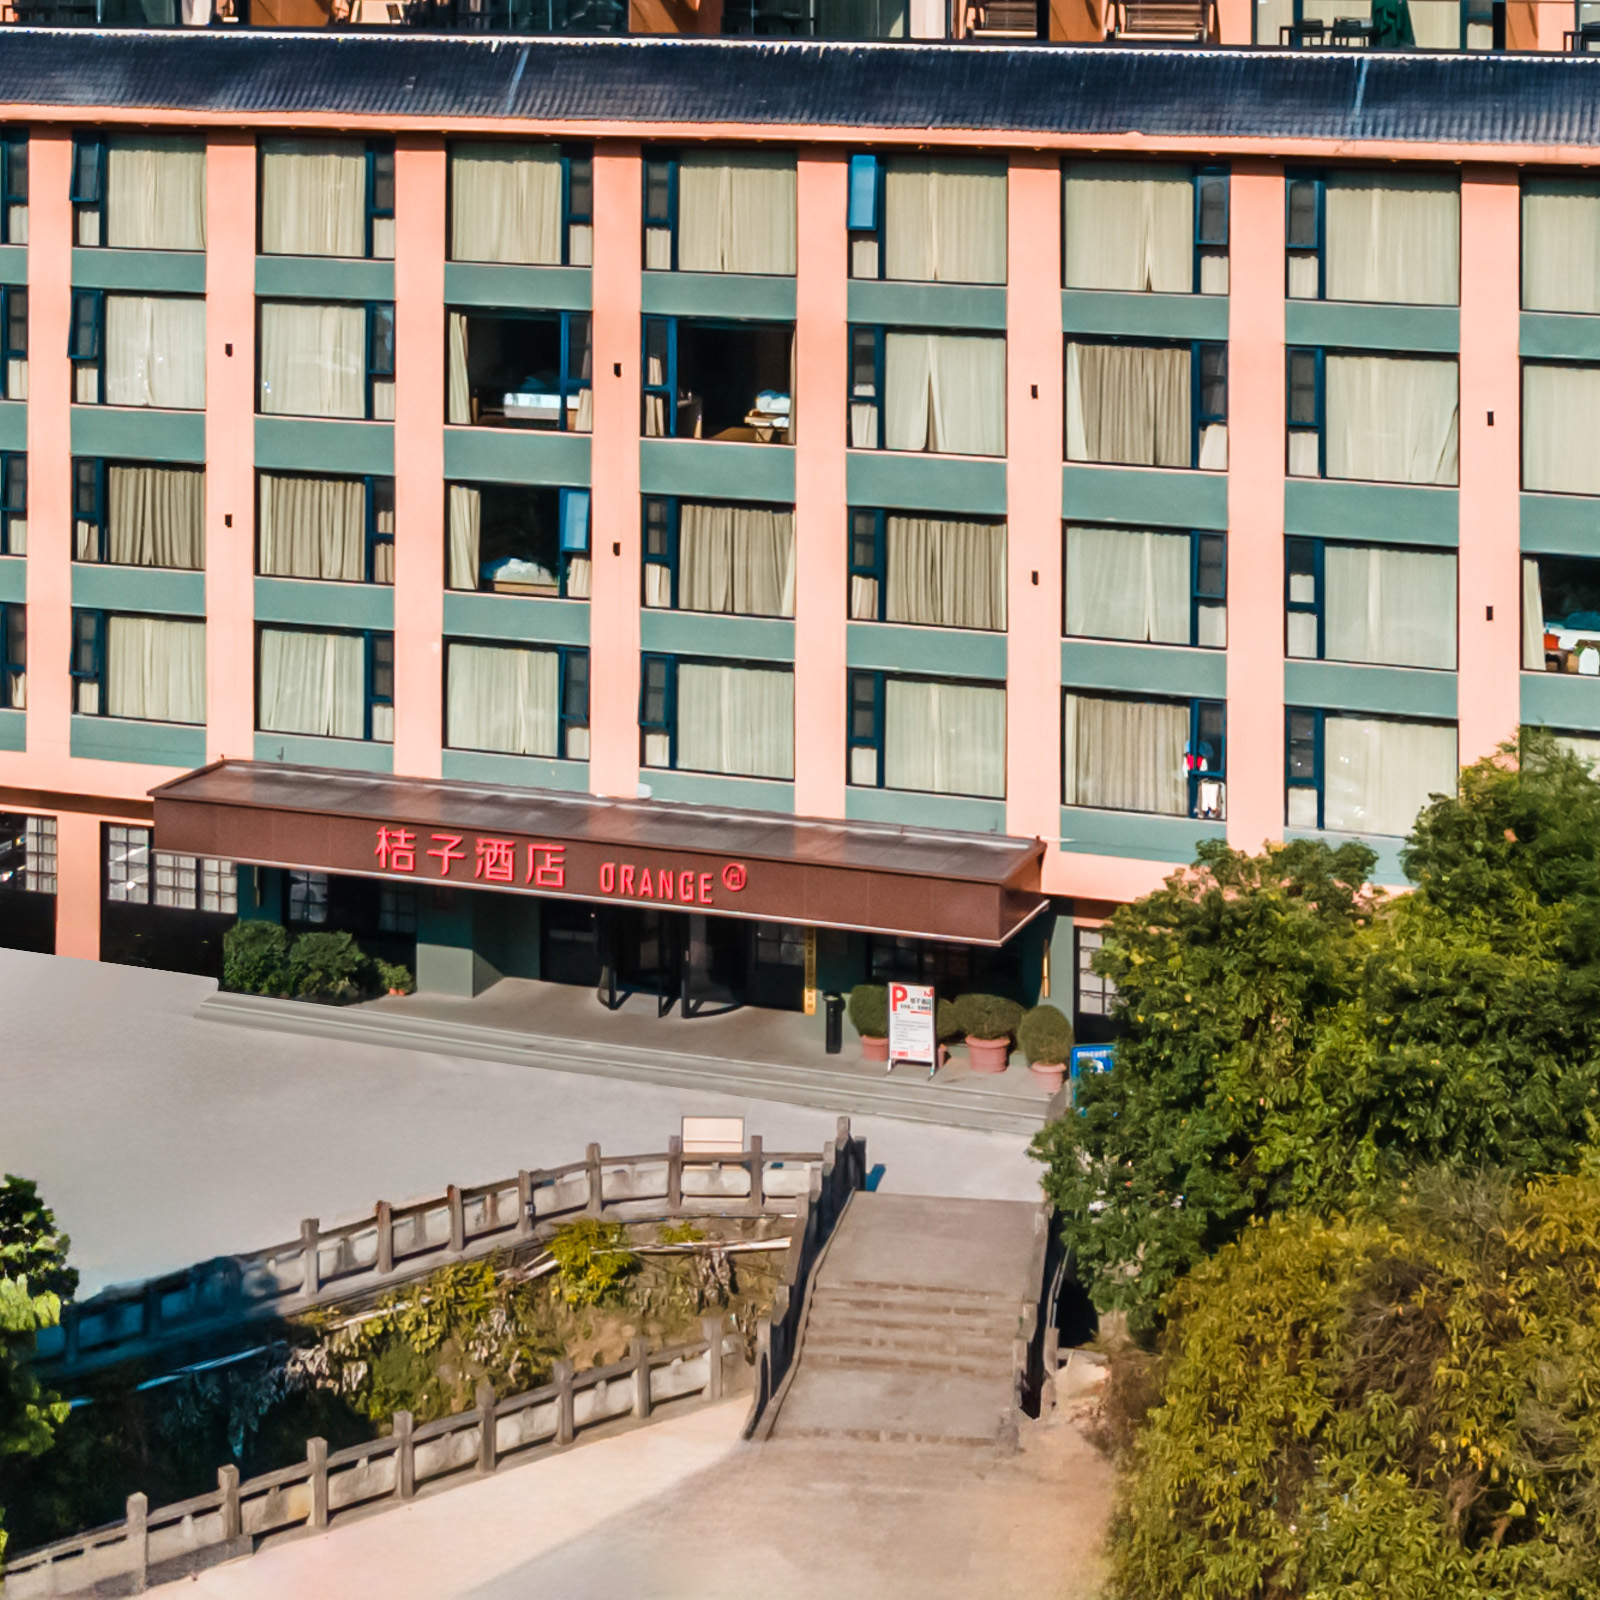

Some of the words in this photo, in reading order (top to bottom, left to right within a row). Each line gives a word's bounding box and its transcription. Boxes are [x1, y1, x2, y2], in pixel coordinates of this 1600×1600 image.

[374, 826, 566, 888] 桔子酒店
[599, 862, 714, 904] ORANGE
